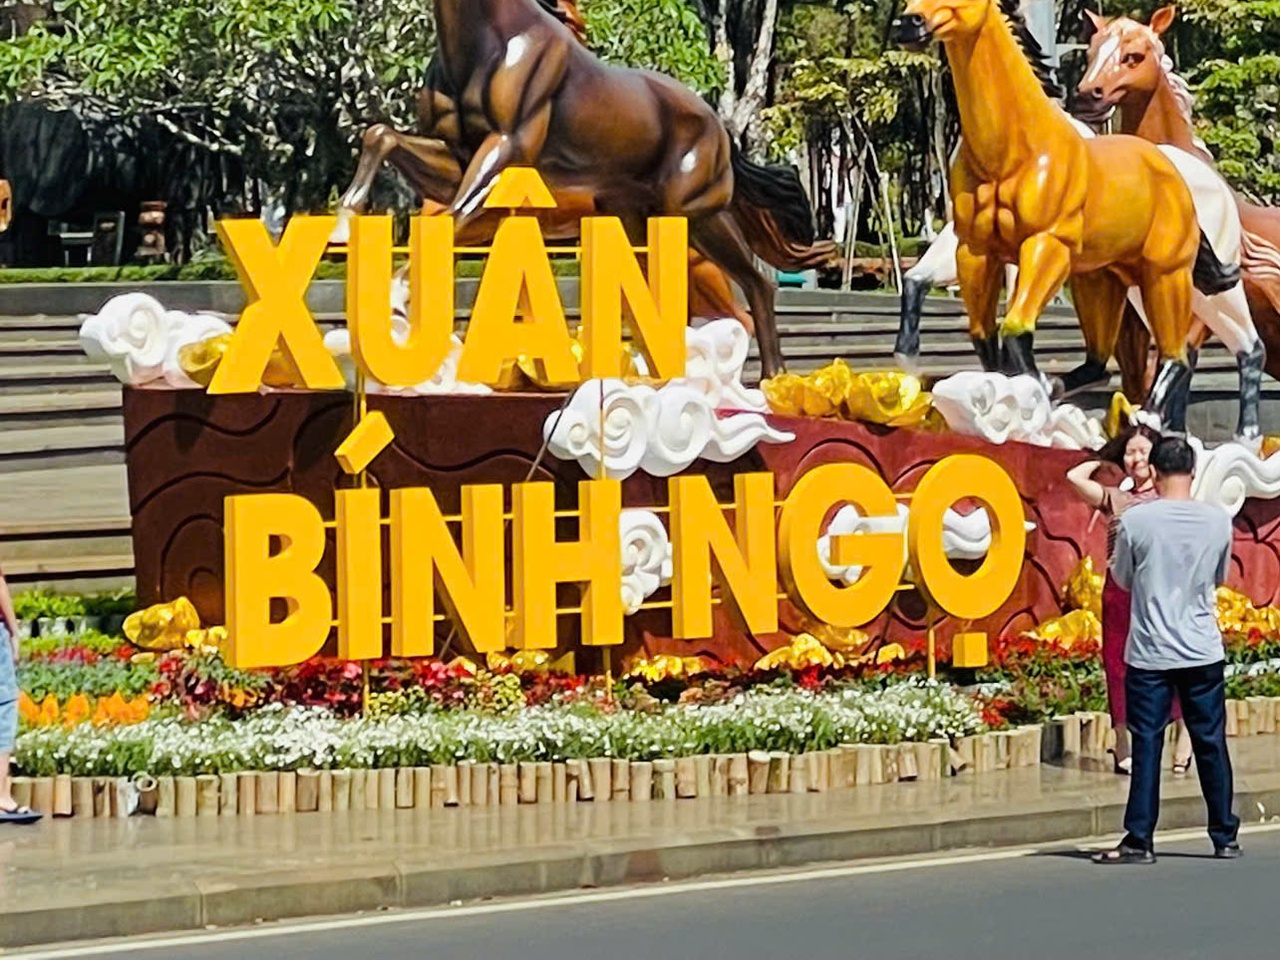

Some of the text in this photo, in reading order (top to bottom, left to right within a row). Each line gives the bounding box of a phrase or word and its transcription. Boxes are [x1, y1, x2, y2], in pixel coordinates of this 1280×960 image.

[208, 167, 689, 394] XUÂN
[224, 410, 1025, 669] BÍNH NGỌ
